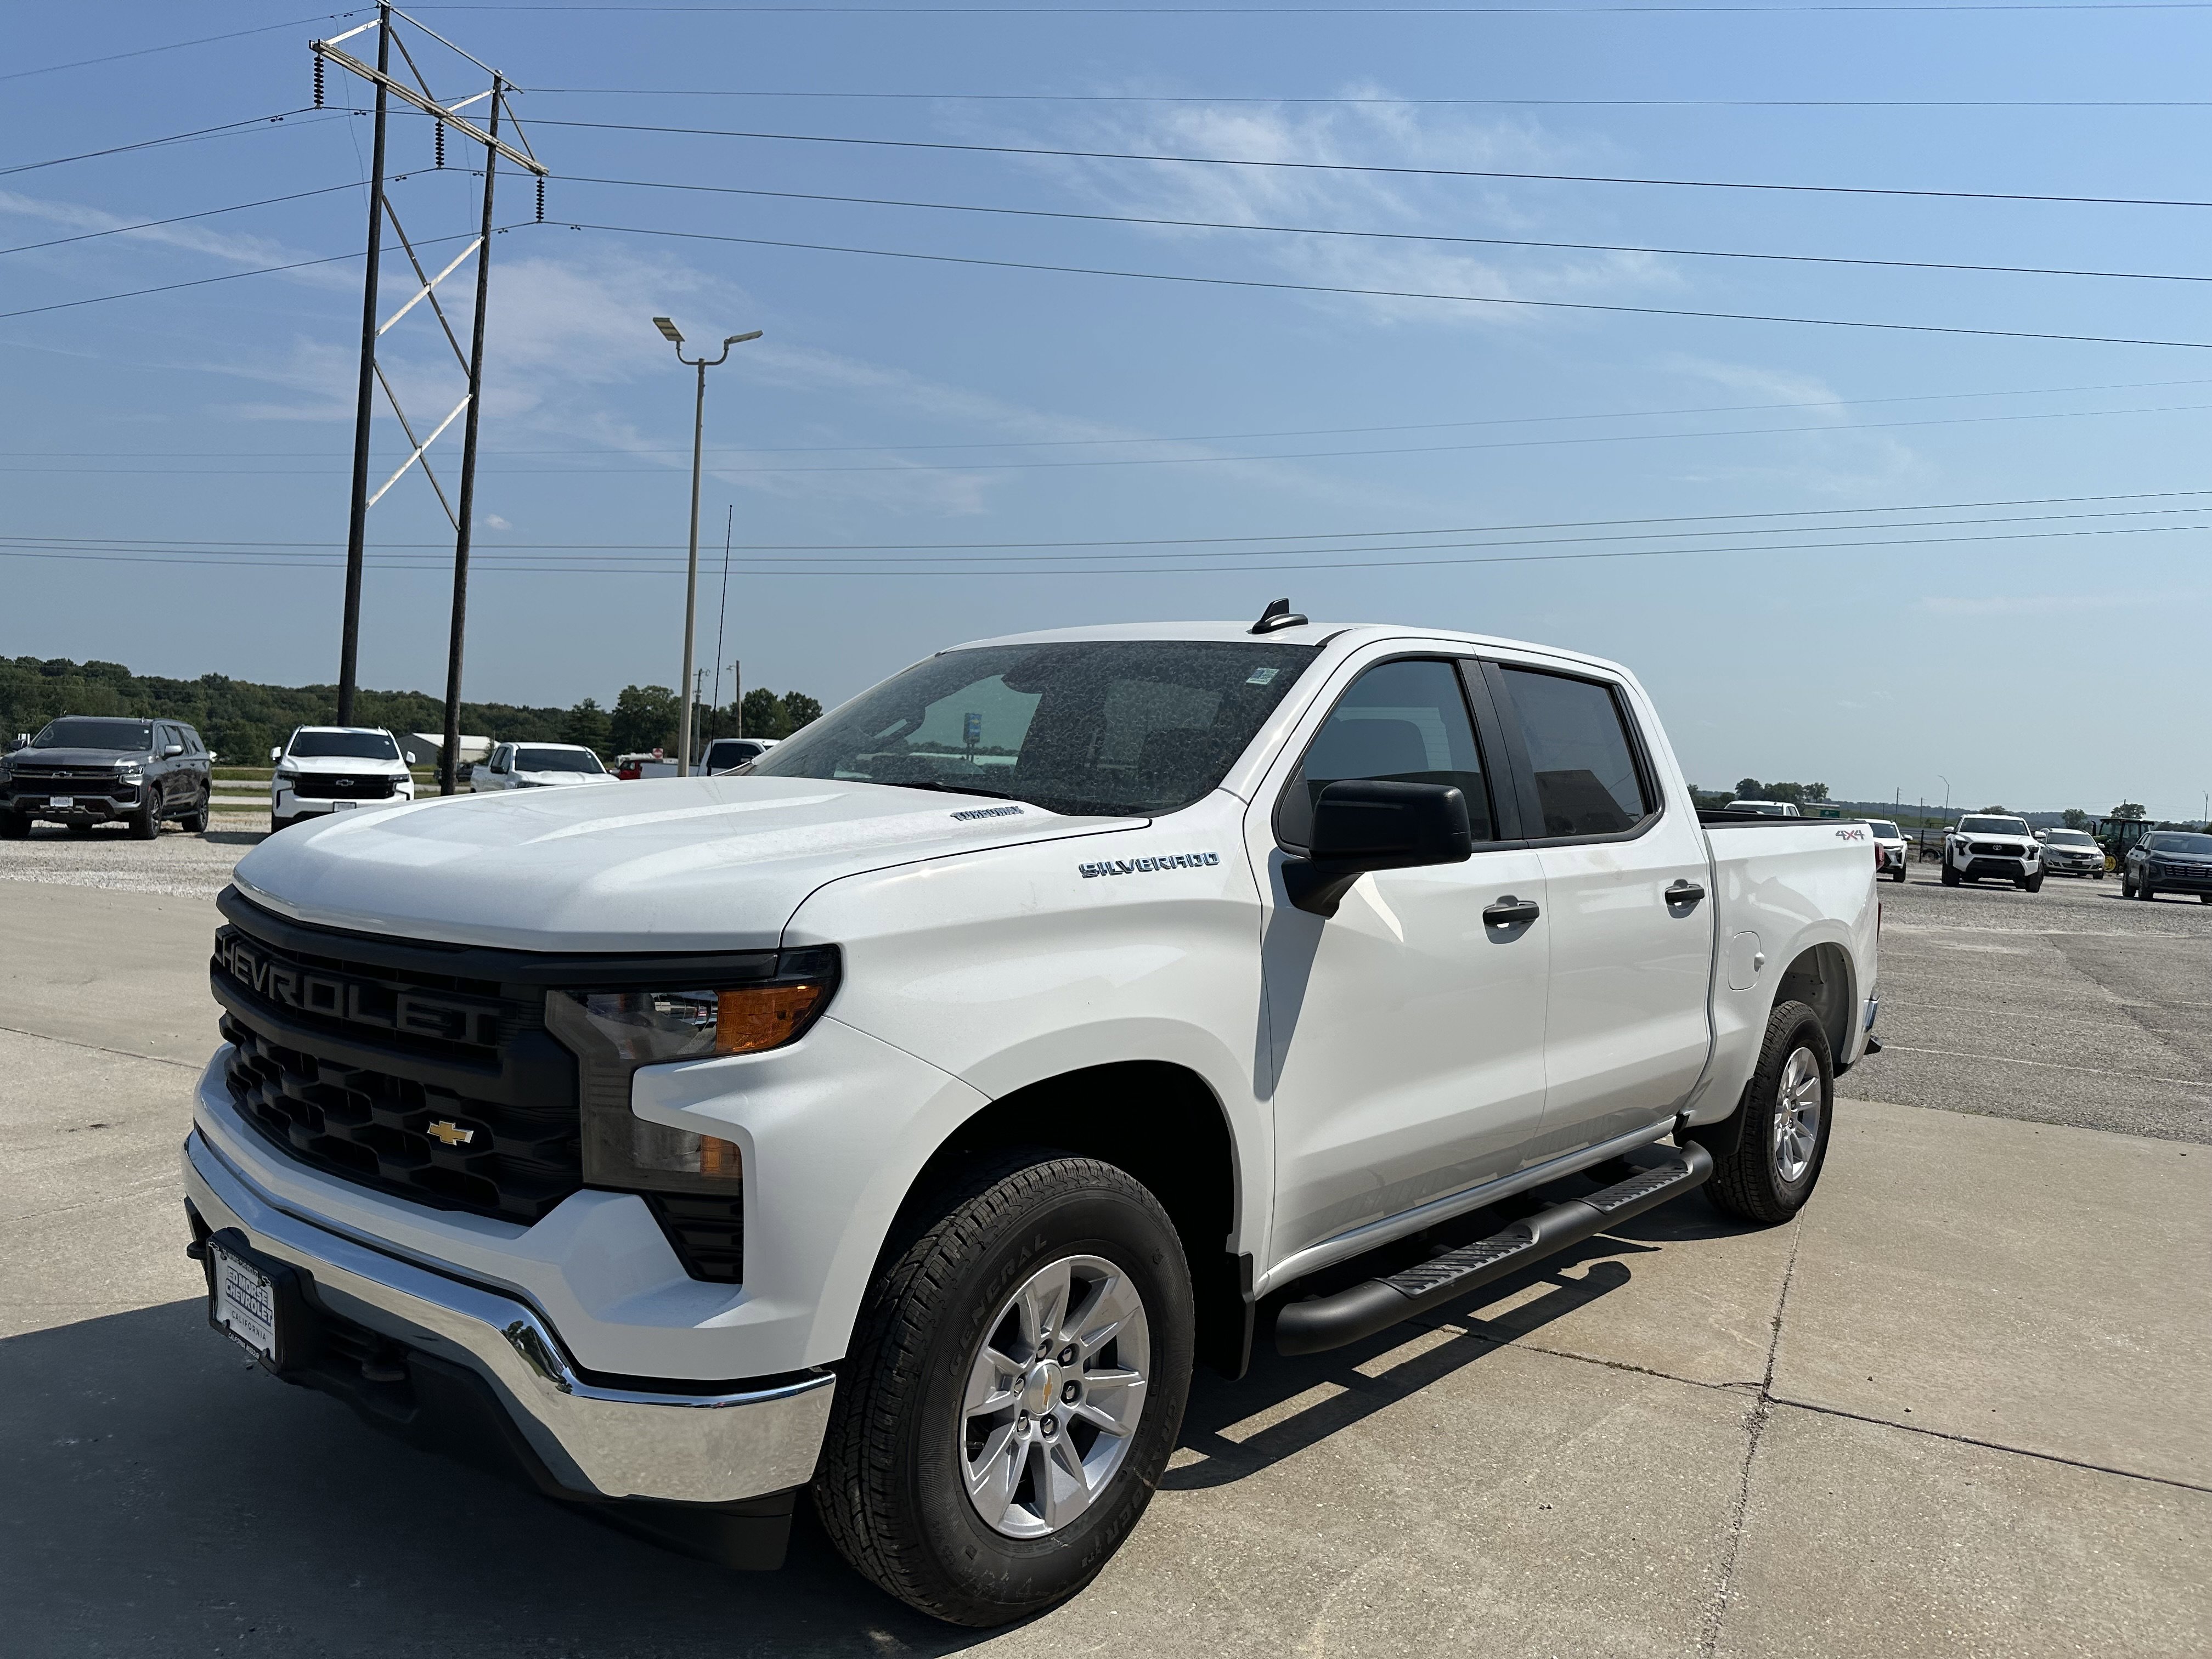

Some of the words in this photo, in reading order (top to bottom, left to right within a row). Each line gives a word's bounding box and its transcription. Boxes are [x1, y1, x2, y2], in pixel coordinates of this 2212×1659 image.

[950, 805, 1025, 821] TURBOMAX
[1078, 851, 1220, 878] SILVERADO
[225, 1279, 273, 1327] CHEVROLET
[227, 1265, 239, 1285] ED
[238, 1273, 268, 1306] MORSE
[950, 1233, 1047, 1376] GENERAL
[232, 1310, 267, 1342] CALIFORNIA
